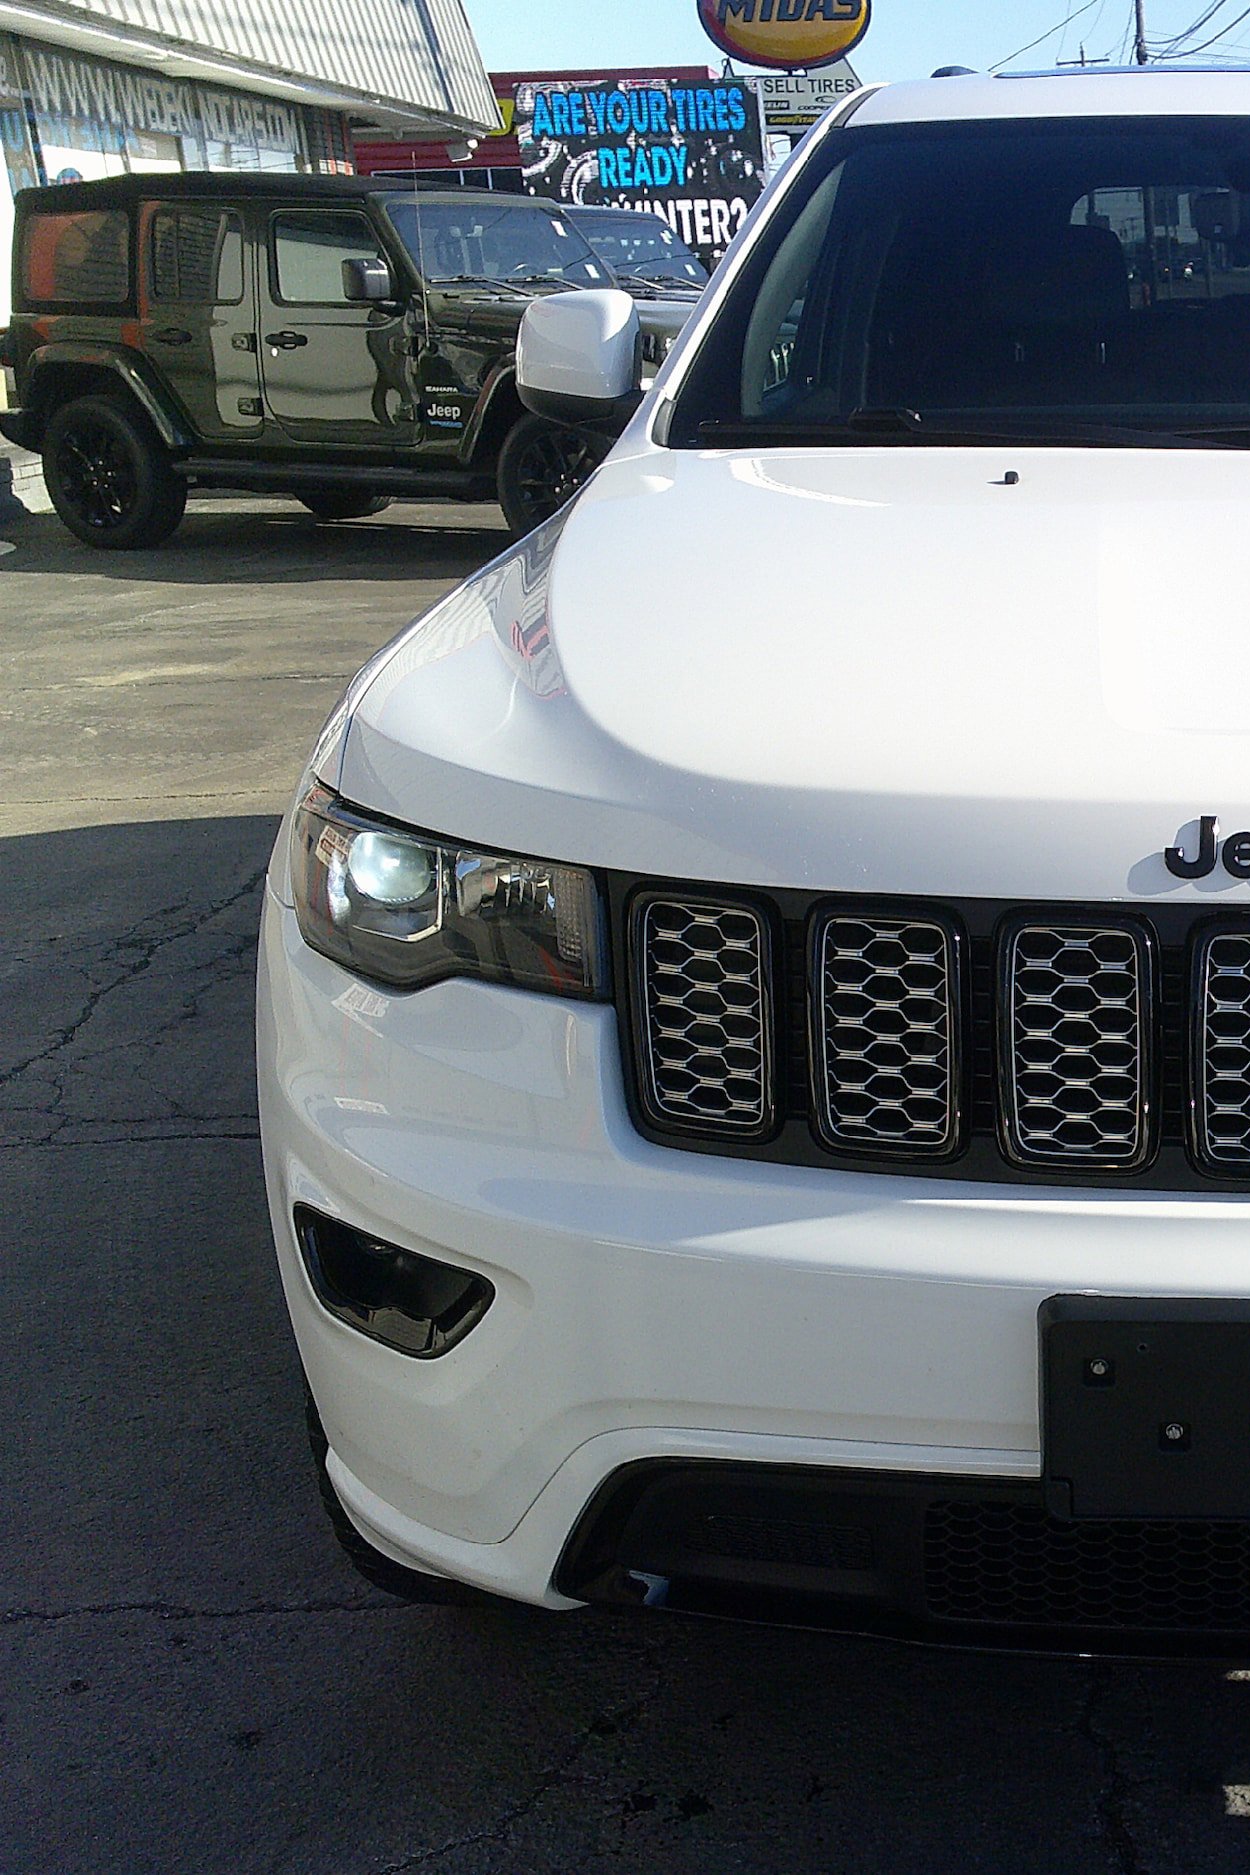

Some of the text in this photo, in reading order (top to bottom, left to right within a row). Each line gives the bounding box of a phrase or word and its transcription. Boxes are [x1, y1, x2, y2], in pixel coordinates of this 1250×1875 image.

[716, 0, 863, 22] MIDAS
[764, 79, 854, 93] SELL TIRES
[533, 87, 747, 137] ARE YOUR TIRES
[597, 145, 688, 188] READY
[611, 197, 748, 245] NTER?
[427, 403, 461, 420] Jeep
